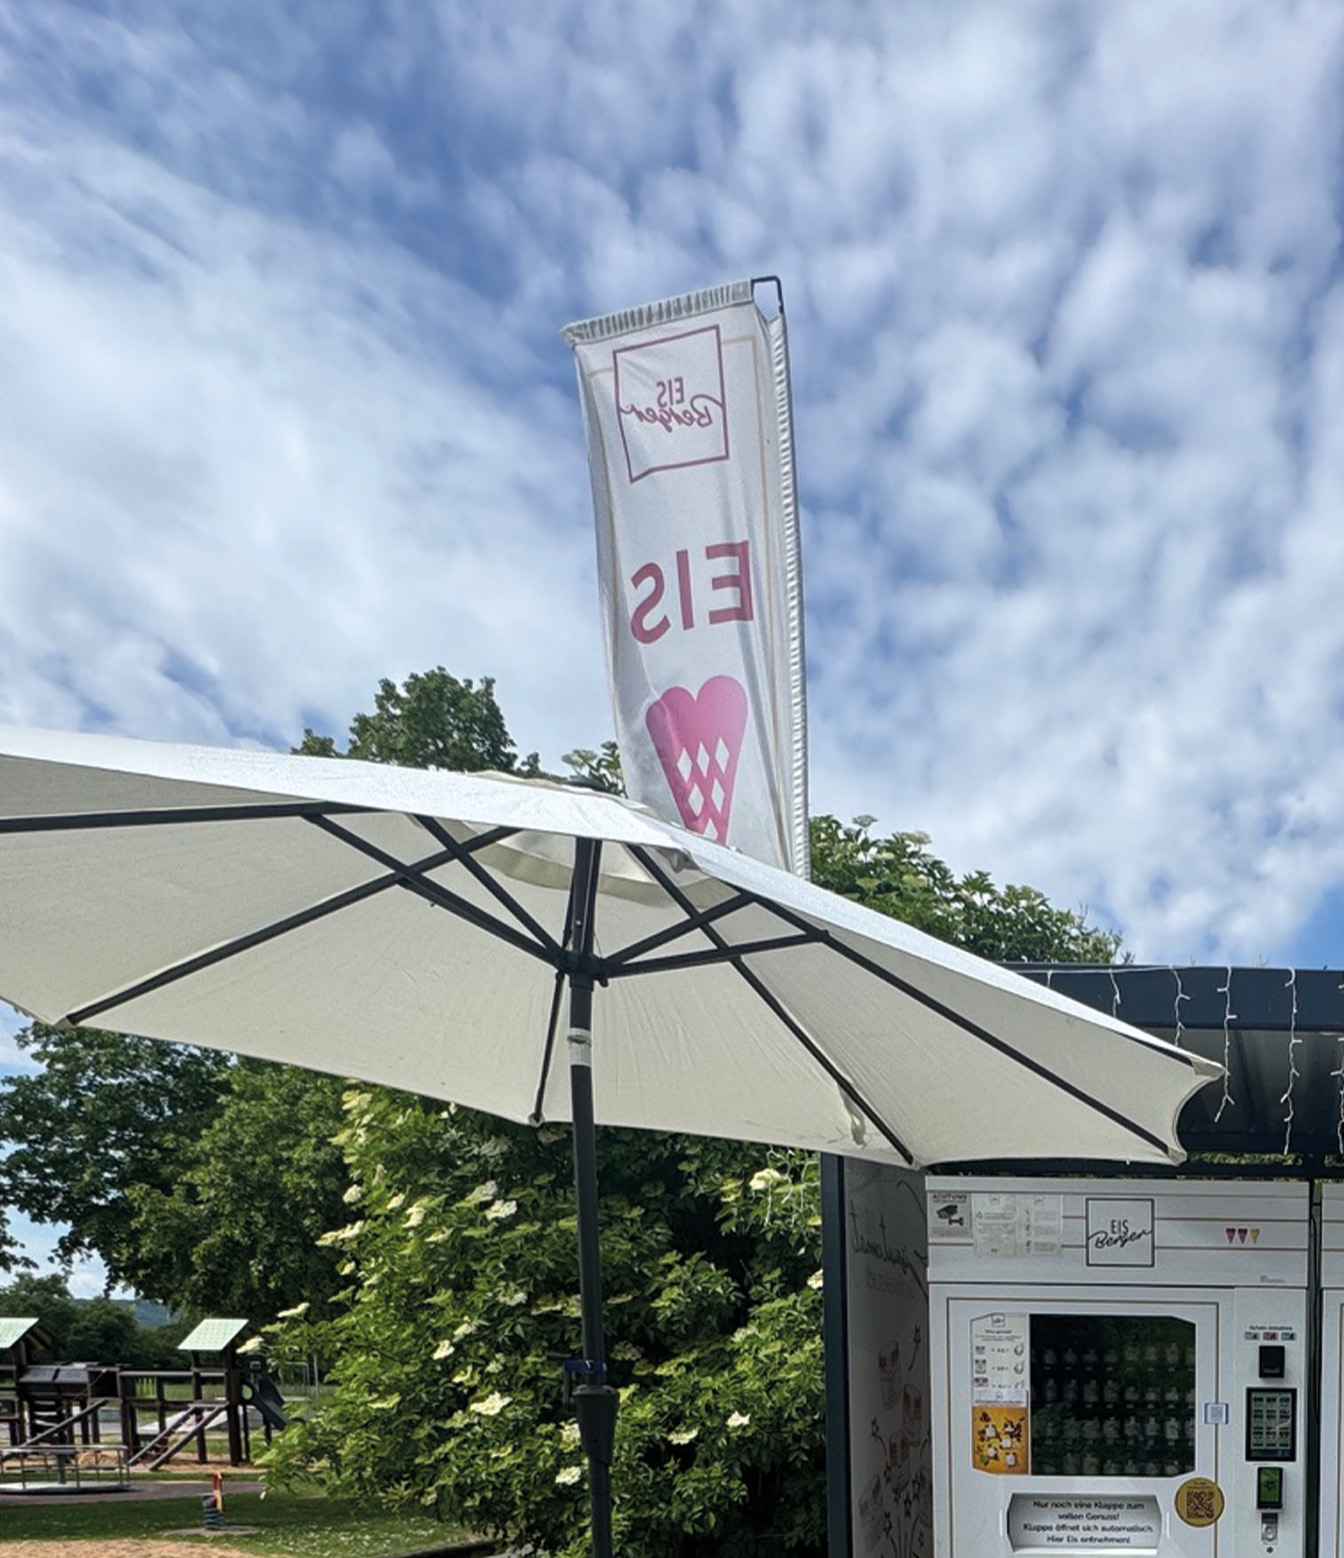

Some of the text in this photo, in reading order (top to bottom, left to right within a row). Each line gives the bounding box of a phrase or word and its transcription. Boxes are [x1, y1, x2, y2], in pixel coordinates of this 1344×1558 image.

[1110, 1219, 1129, 1236] EIS
[1088, 1229, 1153, 1249] Berger
[1051, 1501, 1072, 1509] noch
[1074, 1501, 1092, 1509] eine
[1094, 1500, 1125, 1510] Klappe
[1023, 1523, 1054, 1533] Klappe
